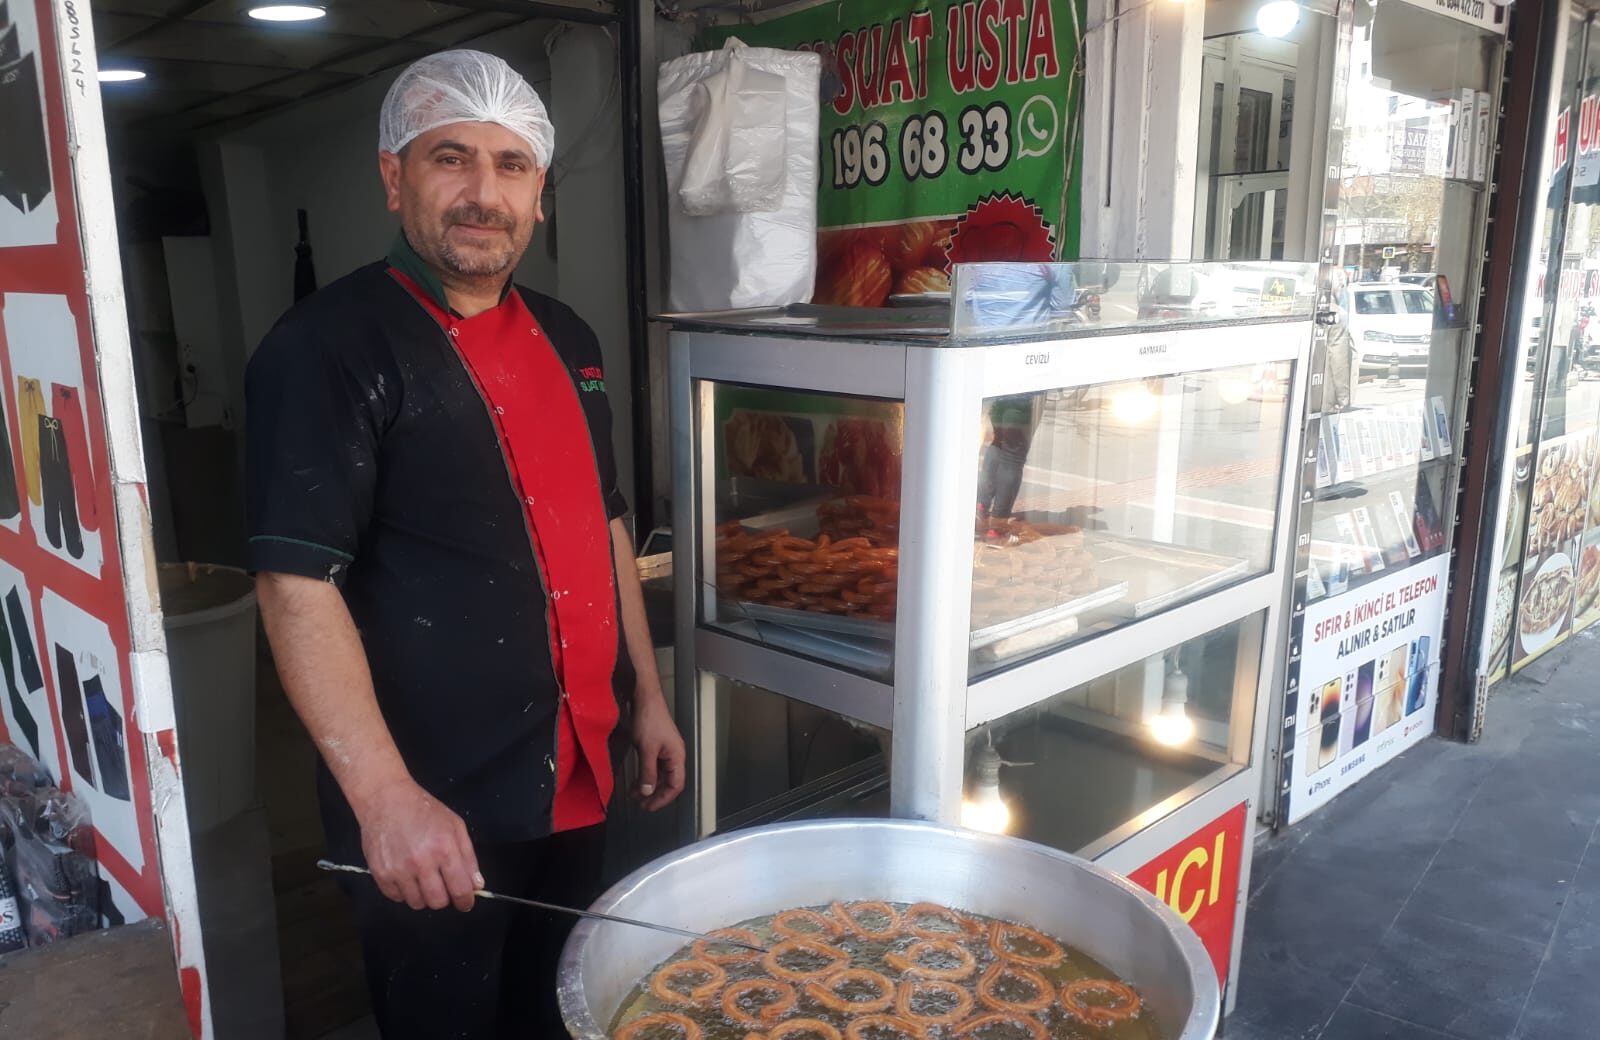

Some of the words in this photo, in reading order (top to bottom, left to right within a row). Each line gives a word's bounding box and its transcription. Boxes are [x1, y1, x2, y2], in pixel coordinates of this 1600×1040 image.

[833, 12, 933, 115] SUAT
[947, 0, 1060, 95] USTA
[831, 121, 889, 188] 196
[900, 111, 948, 180] 68
[958, 102, 1012, 175] 33
[1314, 615, 1341, 643] SIFIR
[1344, 611, 1351, 630] &
[1353, 593, 1384, 626] İKİNCİ
[1385, 592, 1396, 612] EL
[1399, 574, 1438, 606] TELEFON
[1336, 628, 1371, 659] ALINIR
[1373, 624, 1379, 643] &
[1381, 608, 1416, 638] SATILIR
